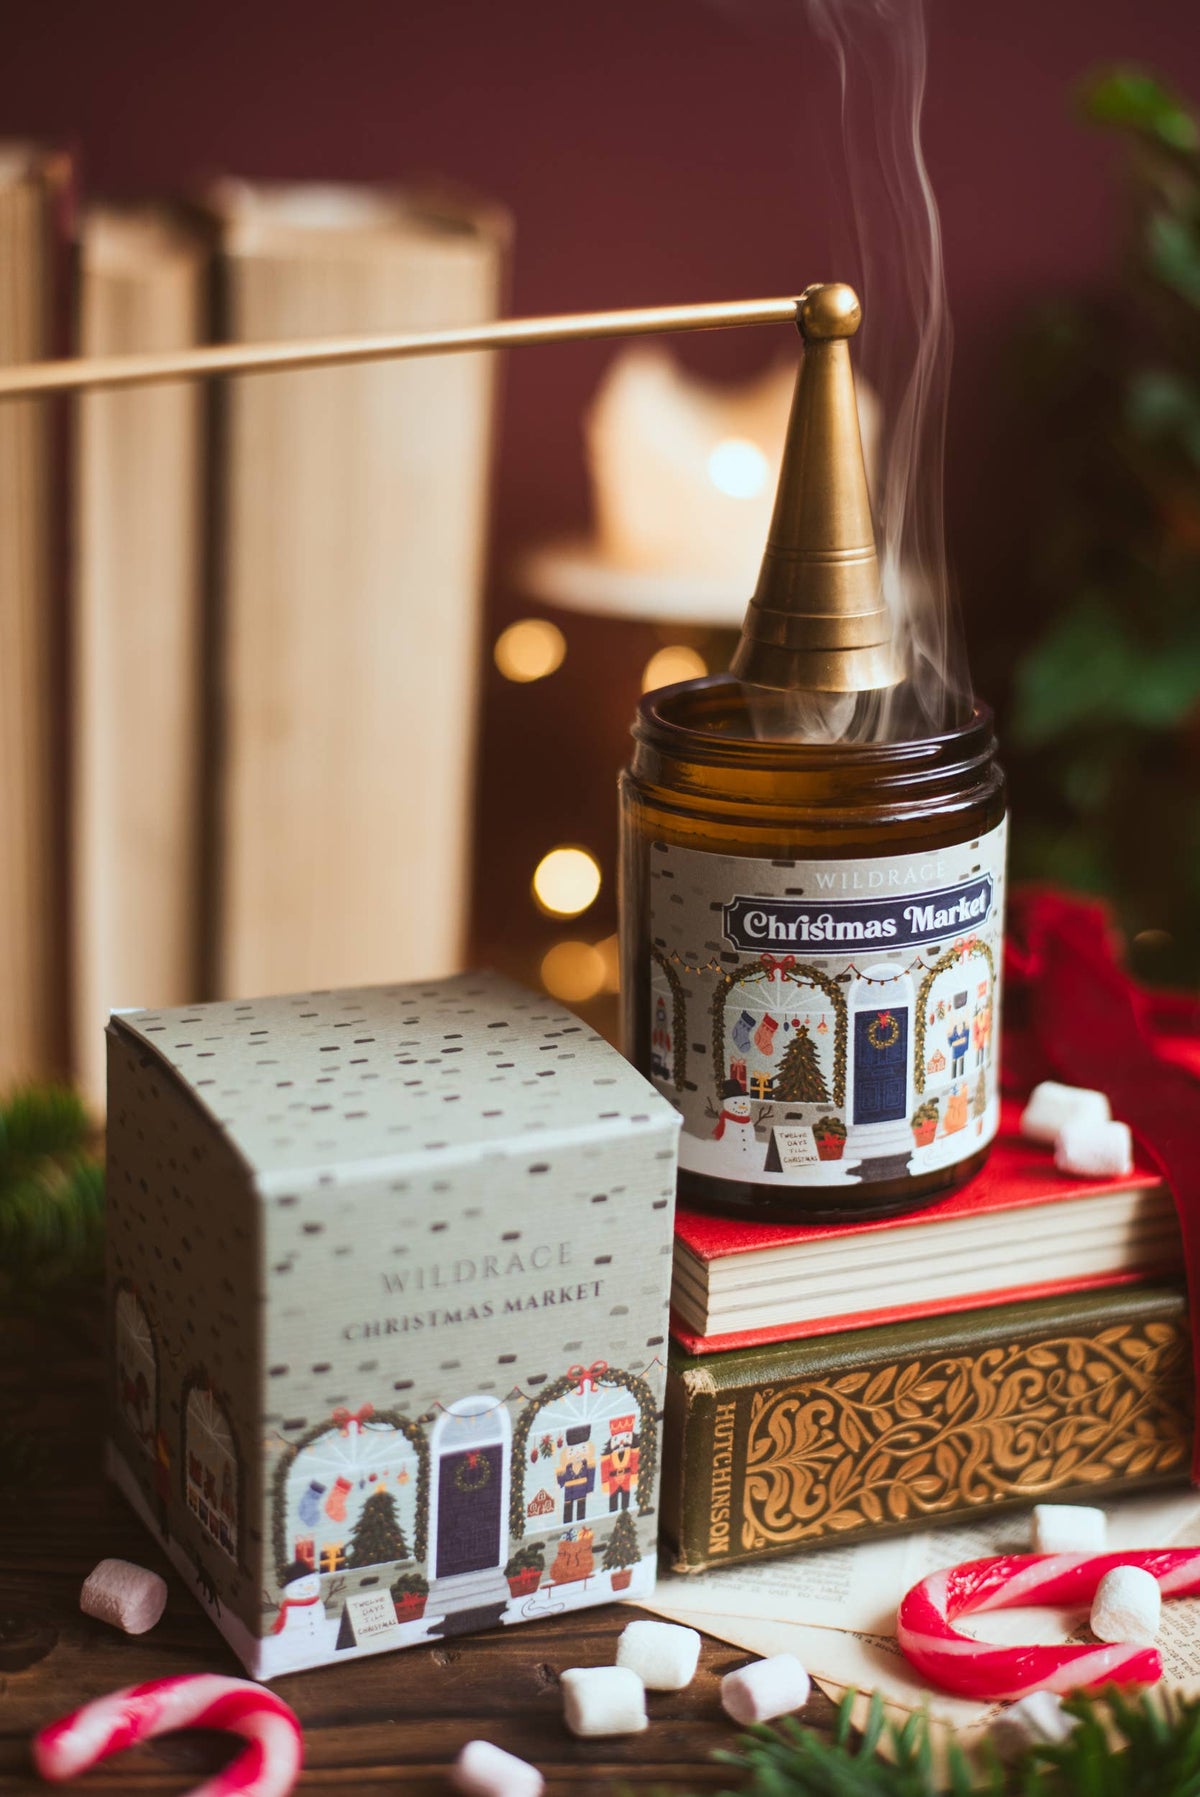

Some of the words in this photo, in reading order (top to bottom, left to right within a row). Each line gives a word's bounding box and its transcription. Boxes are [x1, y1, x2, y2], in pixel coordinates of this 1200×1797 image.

[743, 910, 898, 941] Christmas
[903, 887, 986, 934] Market
[783, 1155, 818, 1164] CHRISTMAS
[787, 1139, 807, 1147] DAYS
[342, 1300, 495, 1341] CHRISTMAS
[503, 1279, 604, 1314] MARKET
[709, 1401, 737, 1554] HUTCHINSON
